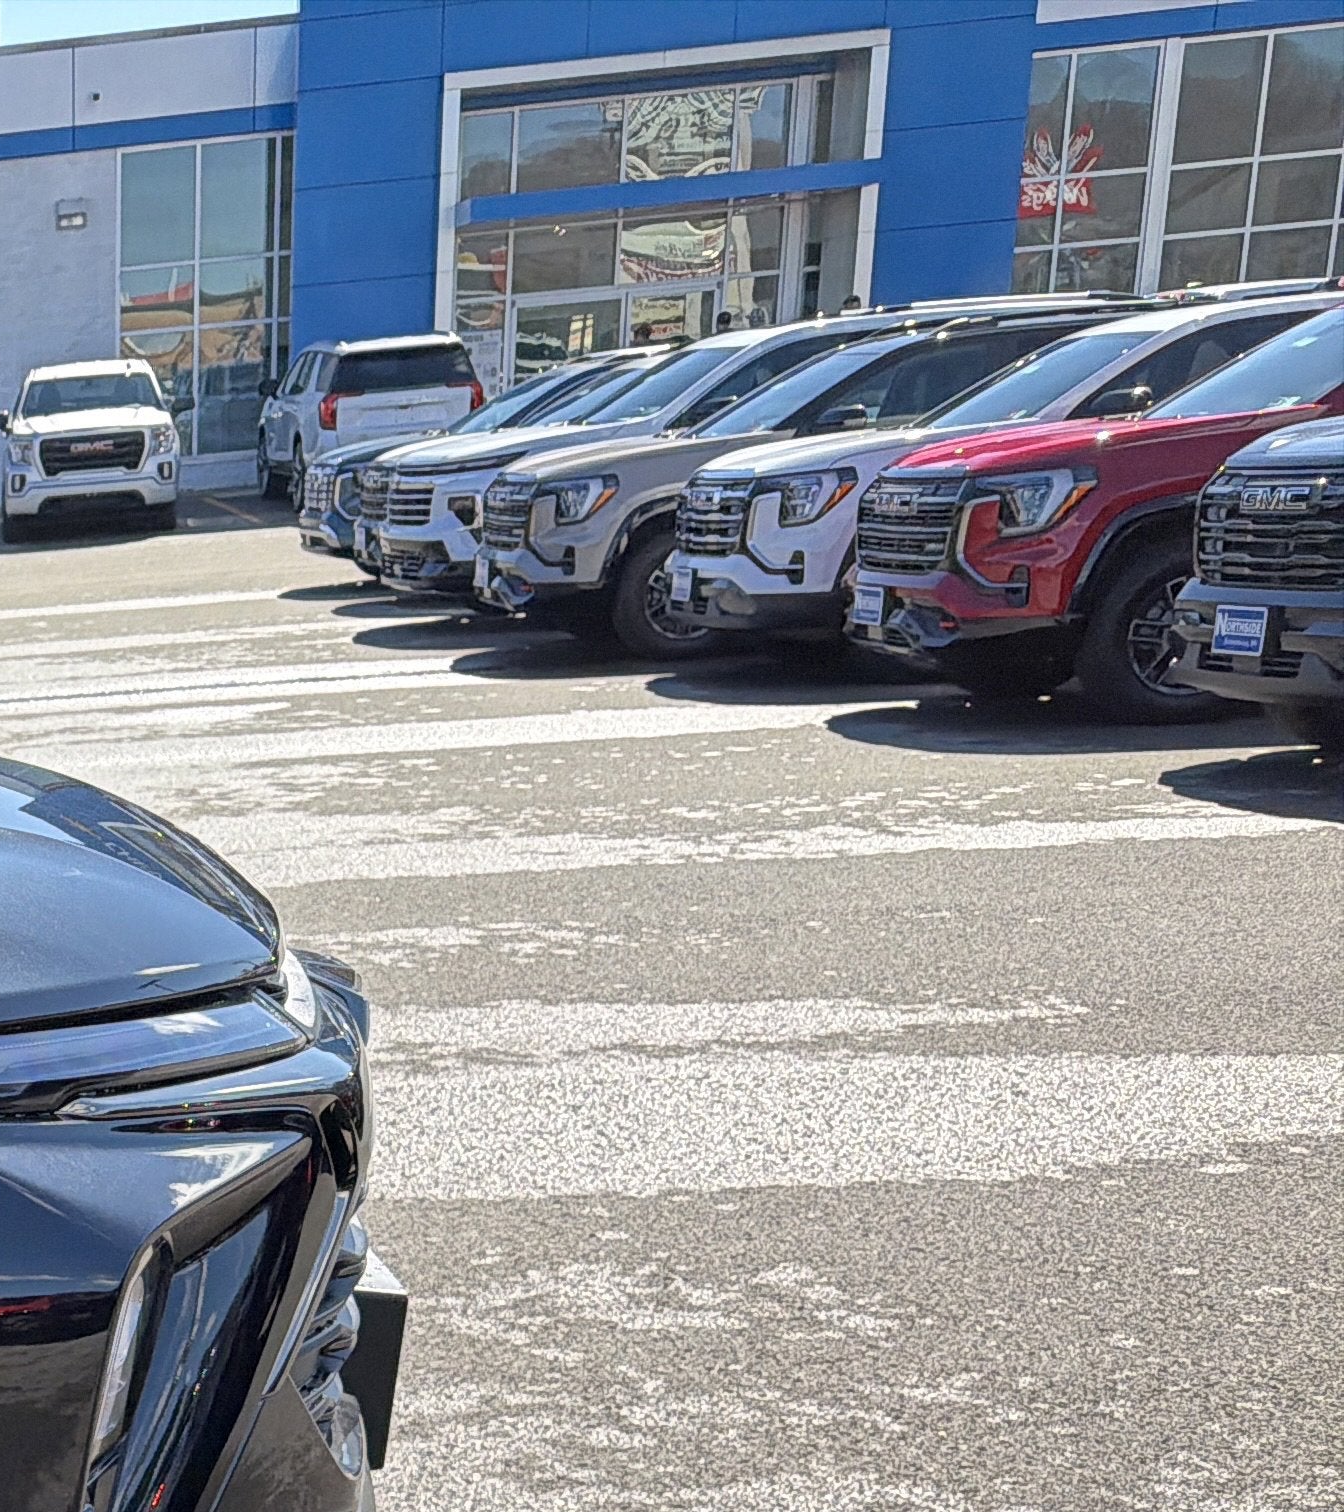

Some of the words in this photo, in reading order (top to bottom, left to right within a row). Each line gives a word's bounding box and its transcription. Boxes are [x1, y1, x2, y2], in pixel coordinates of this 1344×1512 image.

[70, 440, 114, 453] GMC
[1240, 486, 1310, 511] GMC
[1215, 612, 1262, 637] NORTHSIDE
